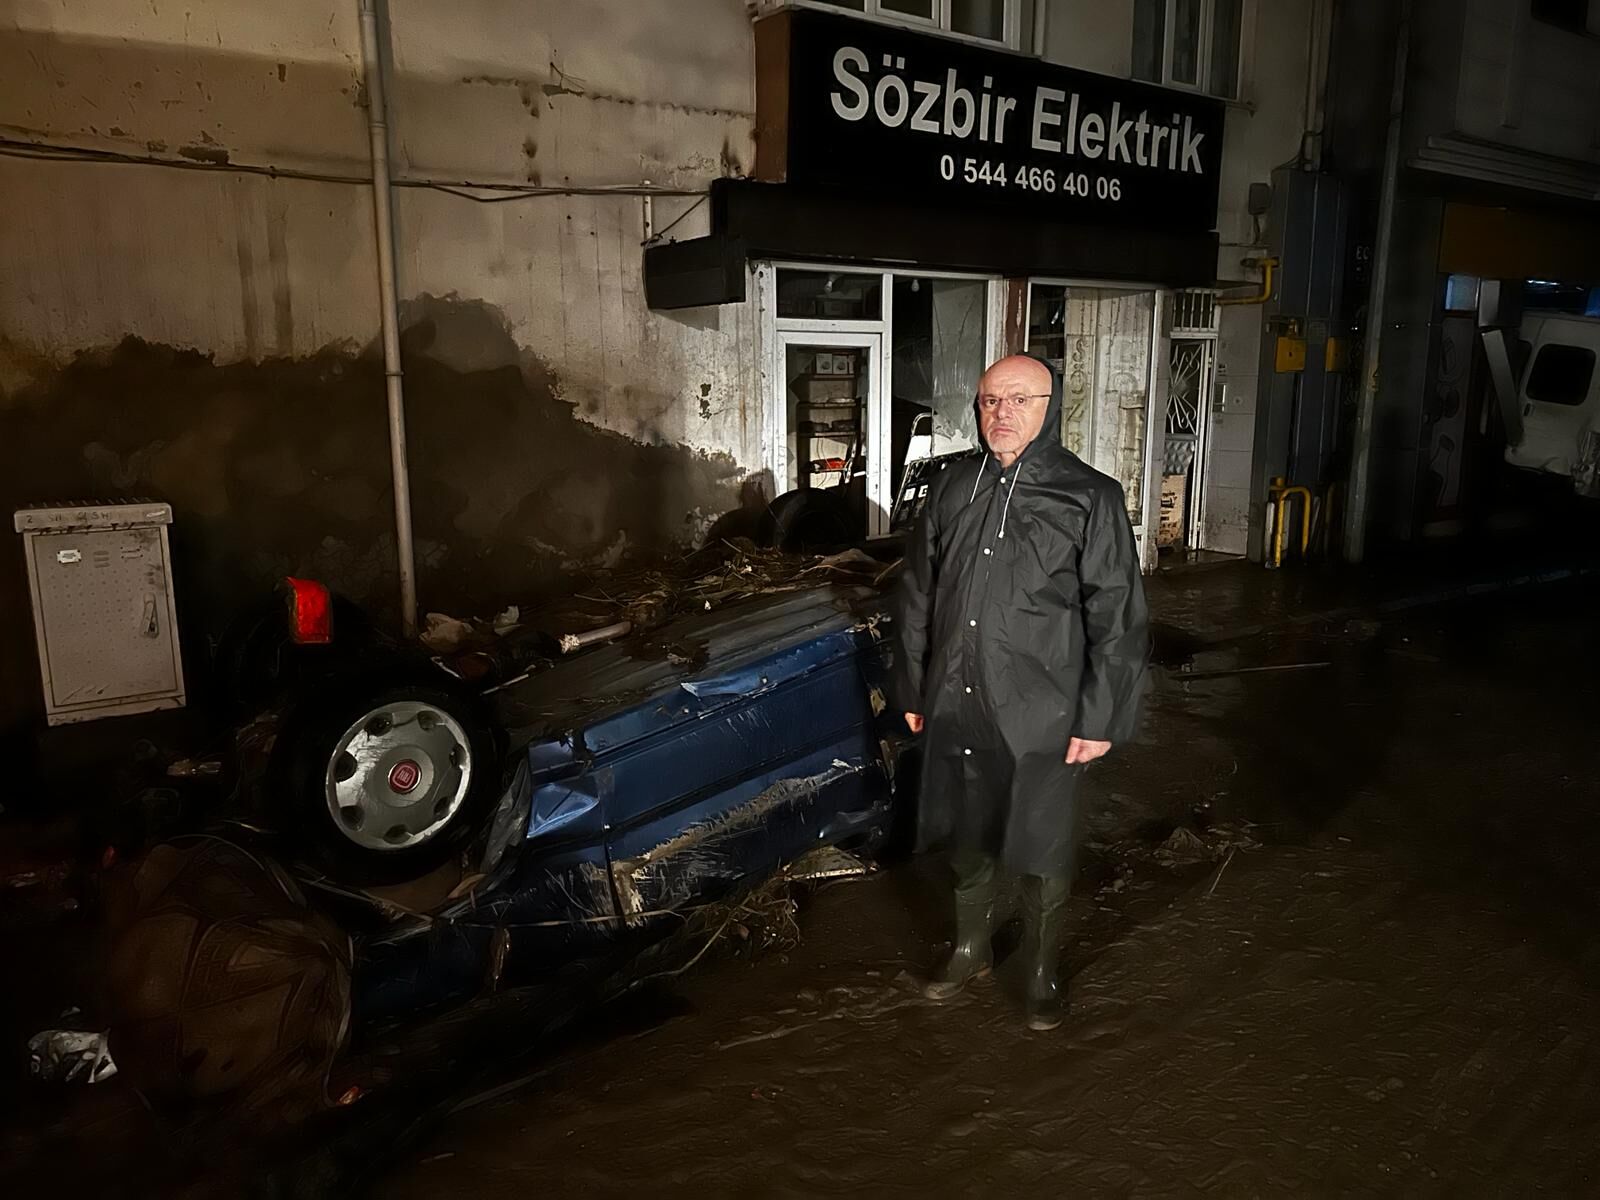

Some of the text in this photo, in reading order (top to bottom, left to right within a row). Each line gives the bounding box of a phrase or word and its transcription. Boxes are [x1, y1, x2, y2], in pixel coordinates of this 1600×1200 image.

[830, 46, 1205, 174] Sözbir Elektrik
[940, 154, 1121, 201] 0 544 466 40 06
